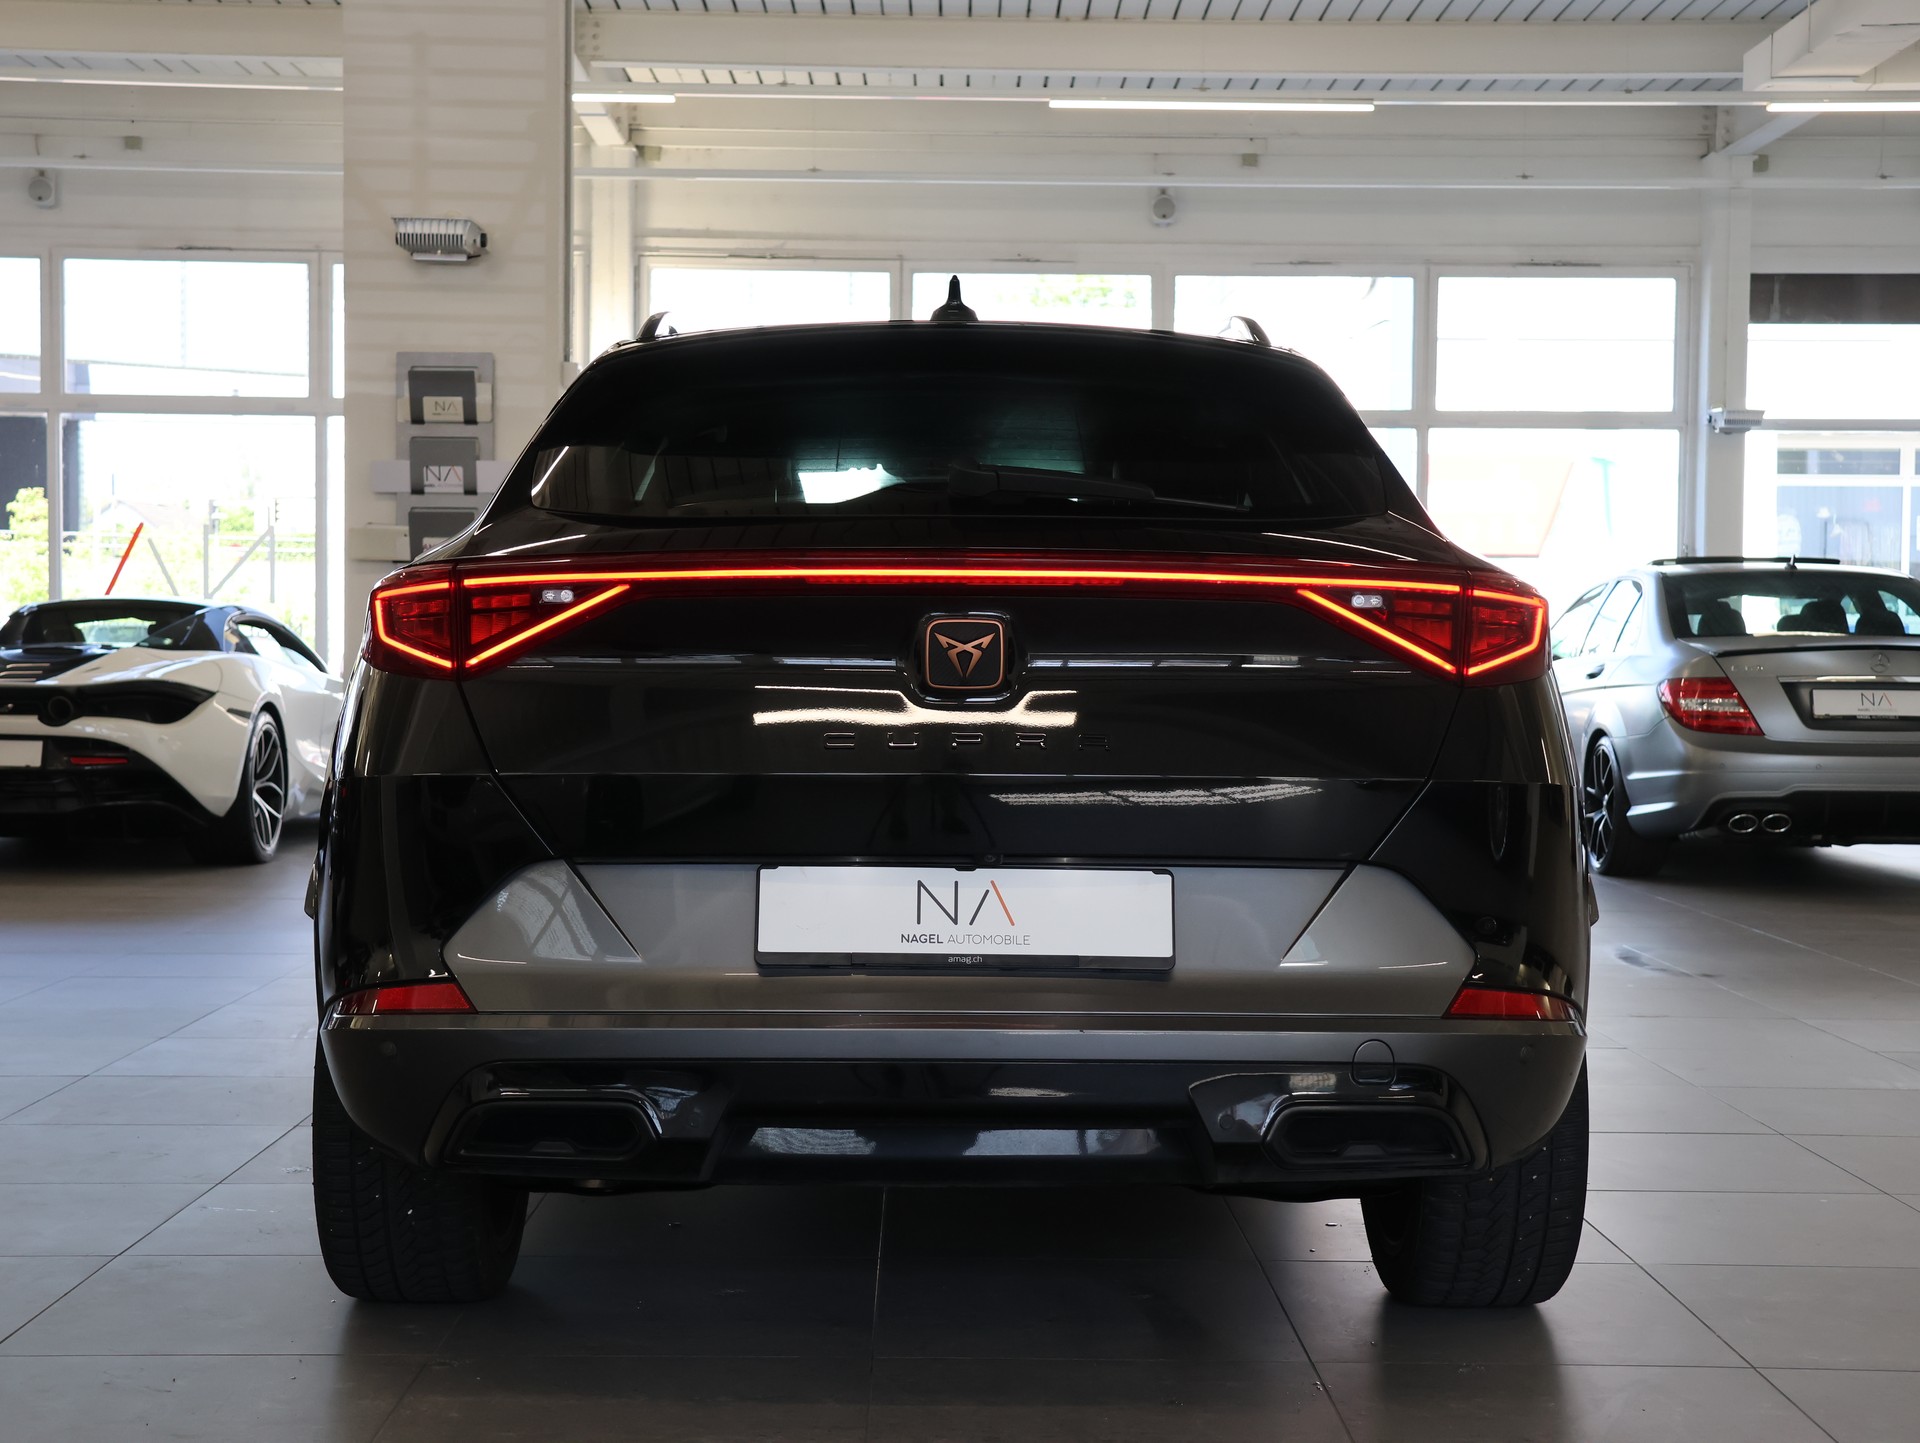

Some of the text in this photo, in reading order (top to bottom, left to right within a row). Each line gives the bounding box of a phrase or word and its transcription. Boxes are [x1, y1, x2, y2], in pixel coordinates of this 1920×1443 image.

[434, 400, 458, 412] NA
[425, 465, 462, 482] NA
[1860, 692, 1892, 707] NA
[823, 731, 1110, 750] CUPRA
[916, 879, 1016, 927] NA
[900, 933, 1031, 946] NAGEL AUTOMOBILE
[947, 955, 983, 965] amag.ch
